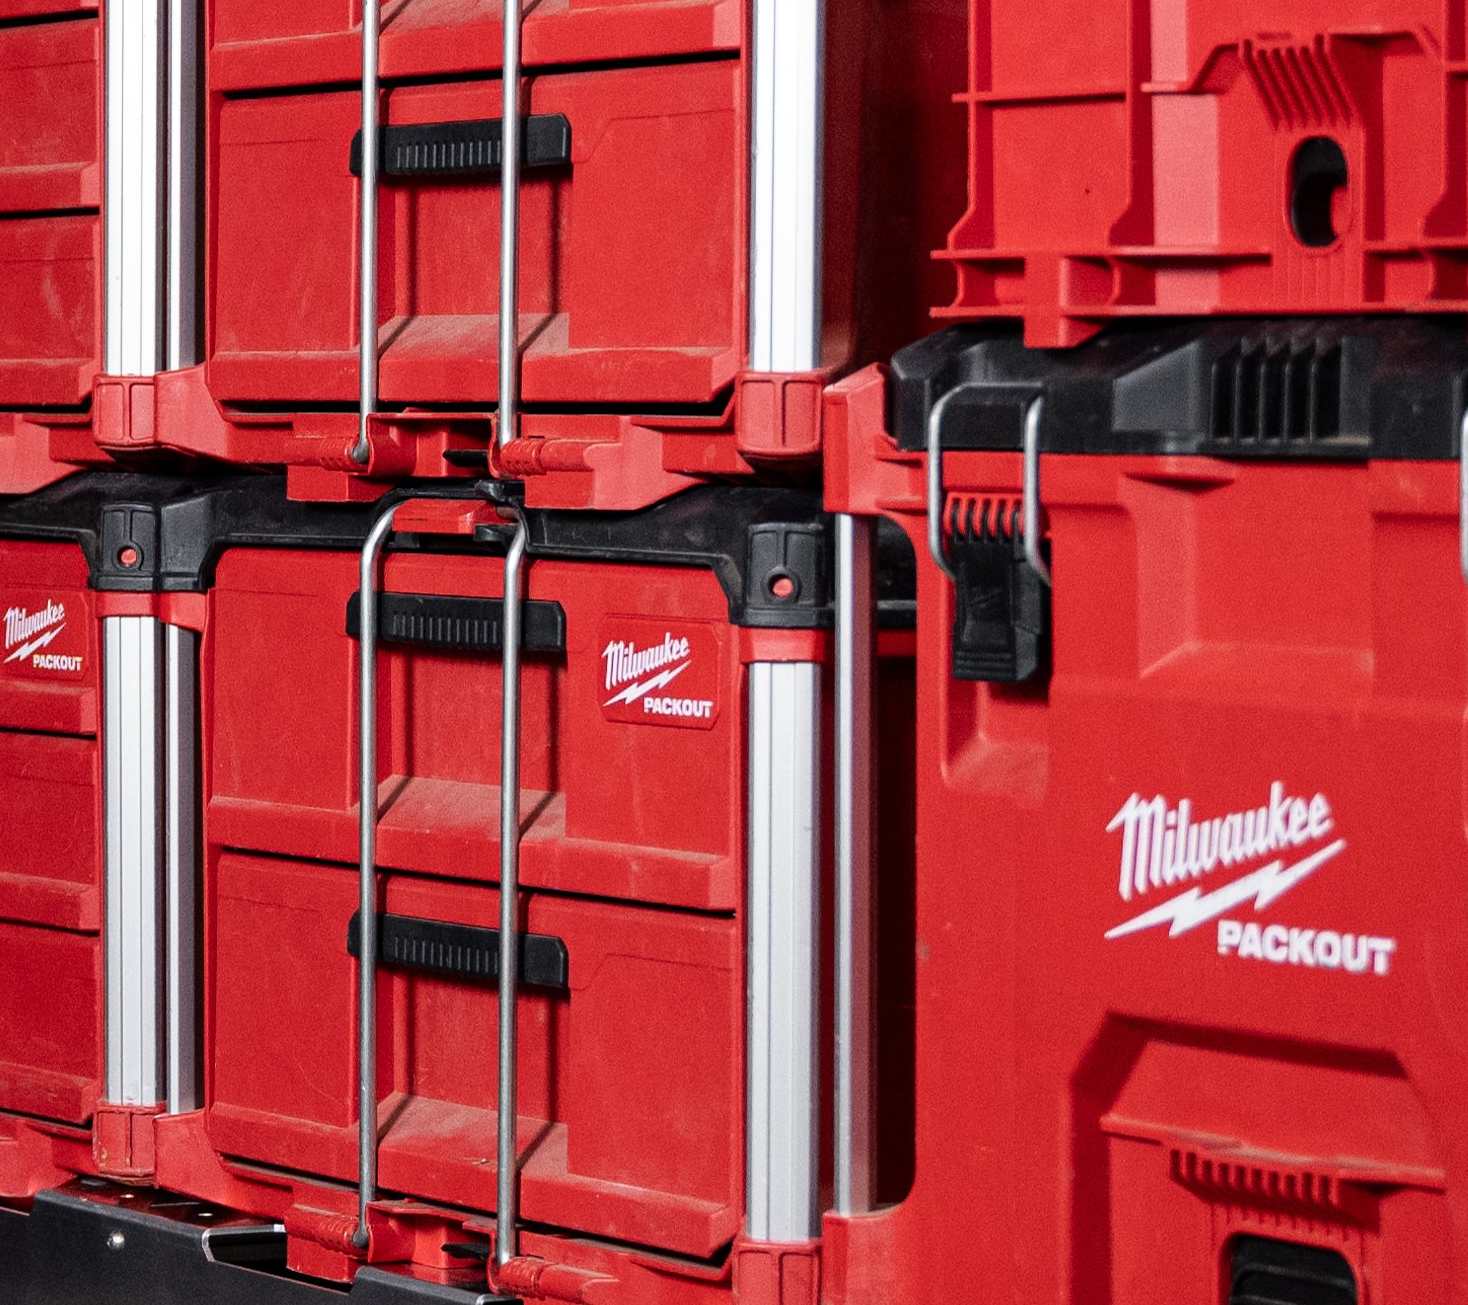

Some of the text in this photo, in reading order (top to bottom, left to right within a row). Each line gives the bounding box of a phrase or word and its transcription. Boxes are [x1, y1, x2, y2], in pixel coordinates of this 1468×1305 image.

[3, 598, 65, 650] Milwaukee
[32, 654, 83, 672] PACKOUT
[601, 631, 691, 692] Milwaukee
[643, 696, 714, 719] PACKOUT
[1105, 780, 1336, 902] Milwaukee
[1217, 919, 1397, 976] PACKOUT
